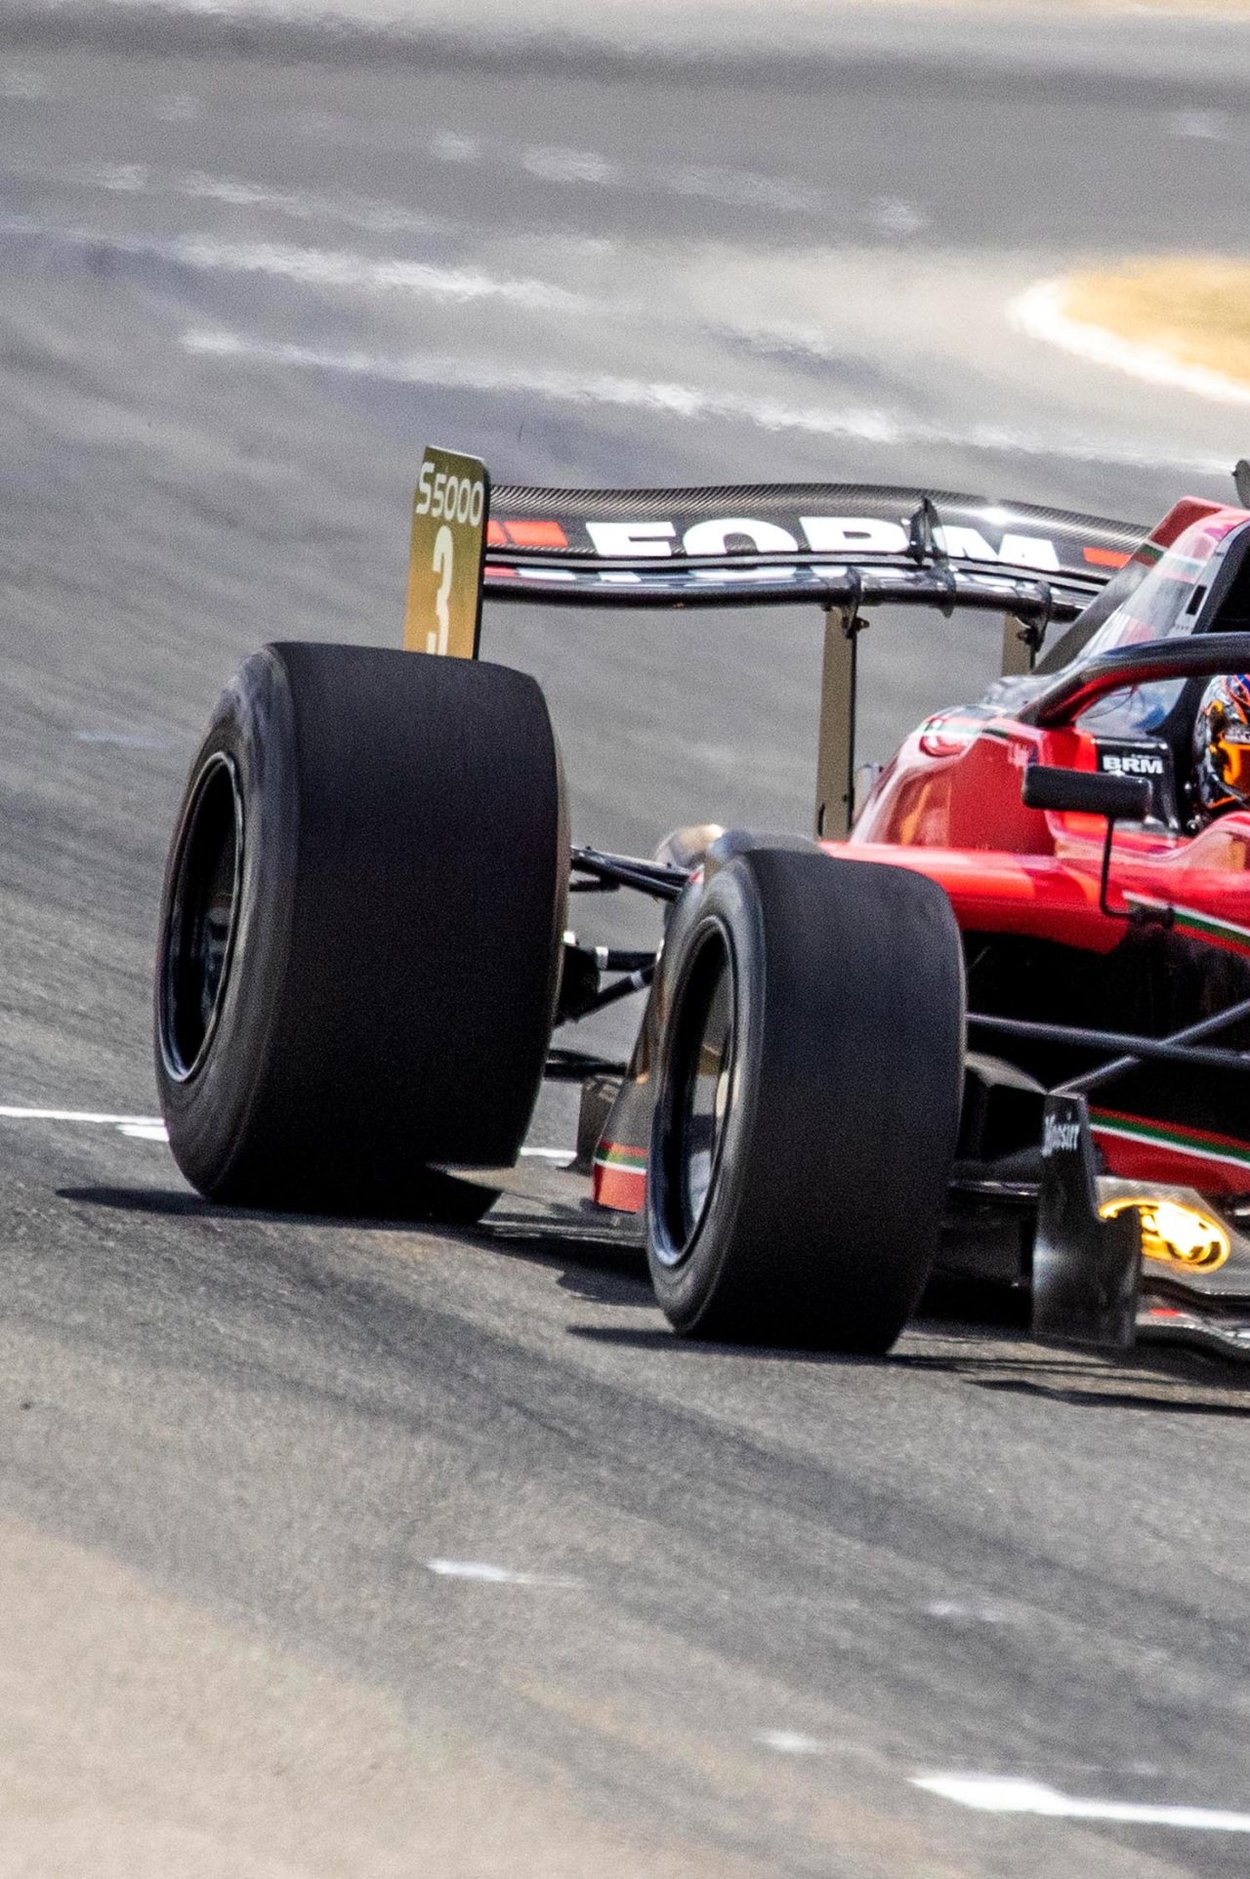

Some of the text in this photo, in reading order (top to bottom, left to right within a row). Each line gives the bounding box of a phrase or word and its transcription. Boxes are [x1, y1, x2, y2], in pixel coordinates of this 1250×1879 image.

[415, 461, 484, 527] S5000
[426, 525, 453, 656] 3
[1102, 755, 1164, 774] BRM
